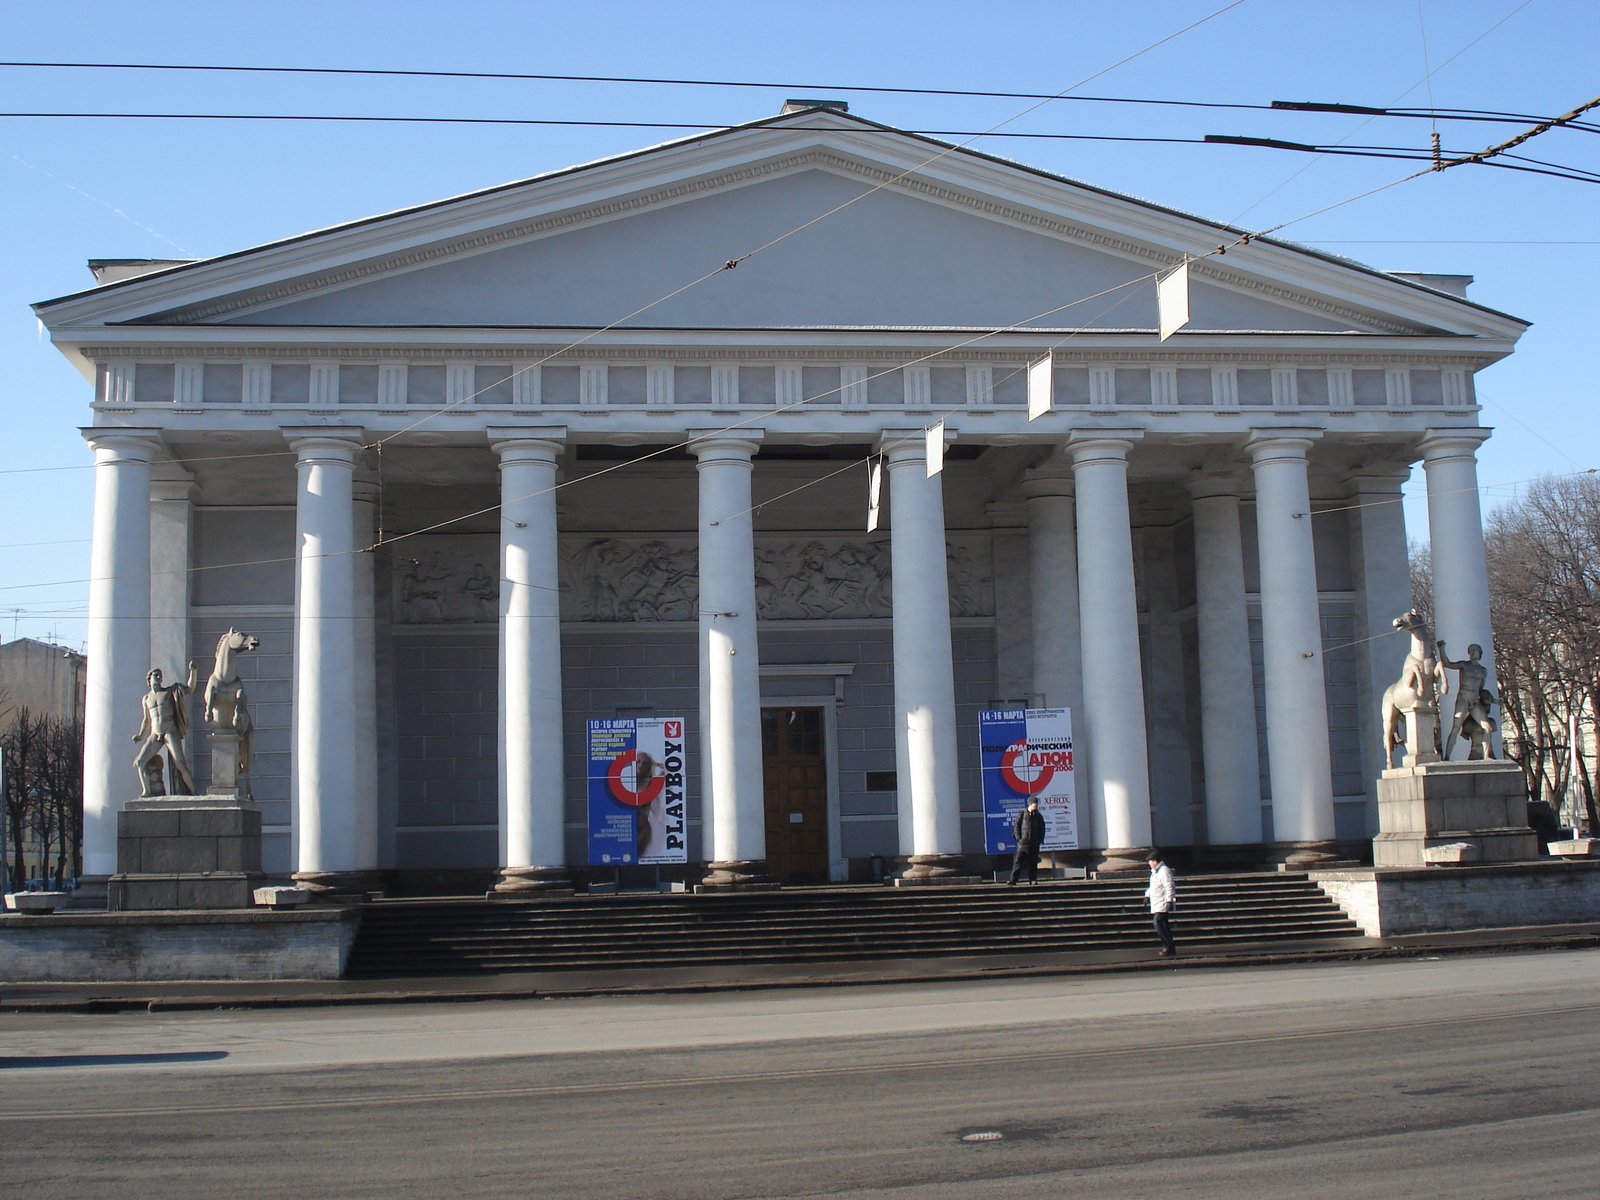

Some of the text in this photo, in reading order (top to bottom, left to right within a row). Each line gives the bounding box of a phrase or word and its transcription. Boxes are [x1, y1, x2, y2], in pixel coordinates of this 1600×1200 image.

[1003, 710, 1024, 720] МАРТА
[612, 719, 635, 729] МАРТА
[664, 740, 684, 850] PLAYBOY
[1044, 796, 1070, 805] XEROX
